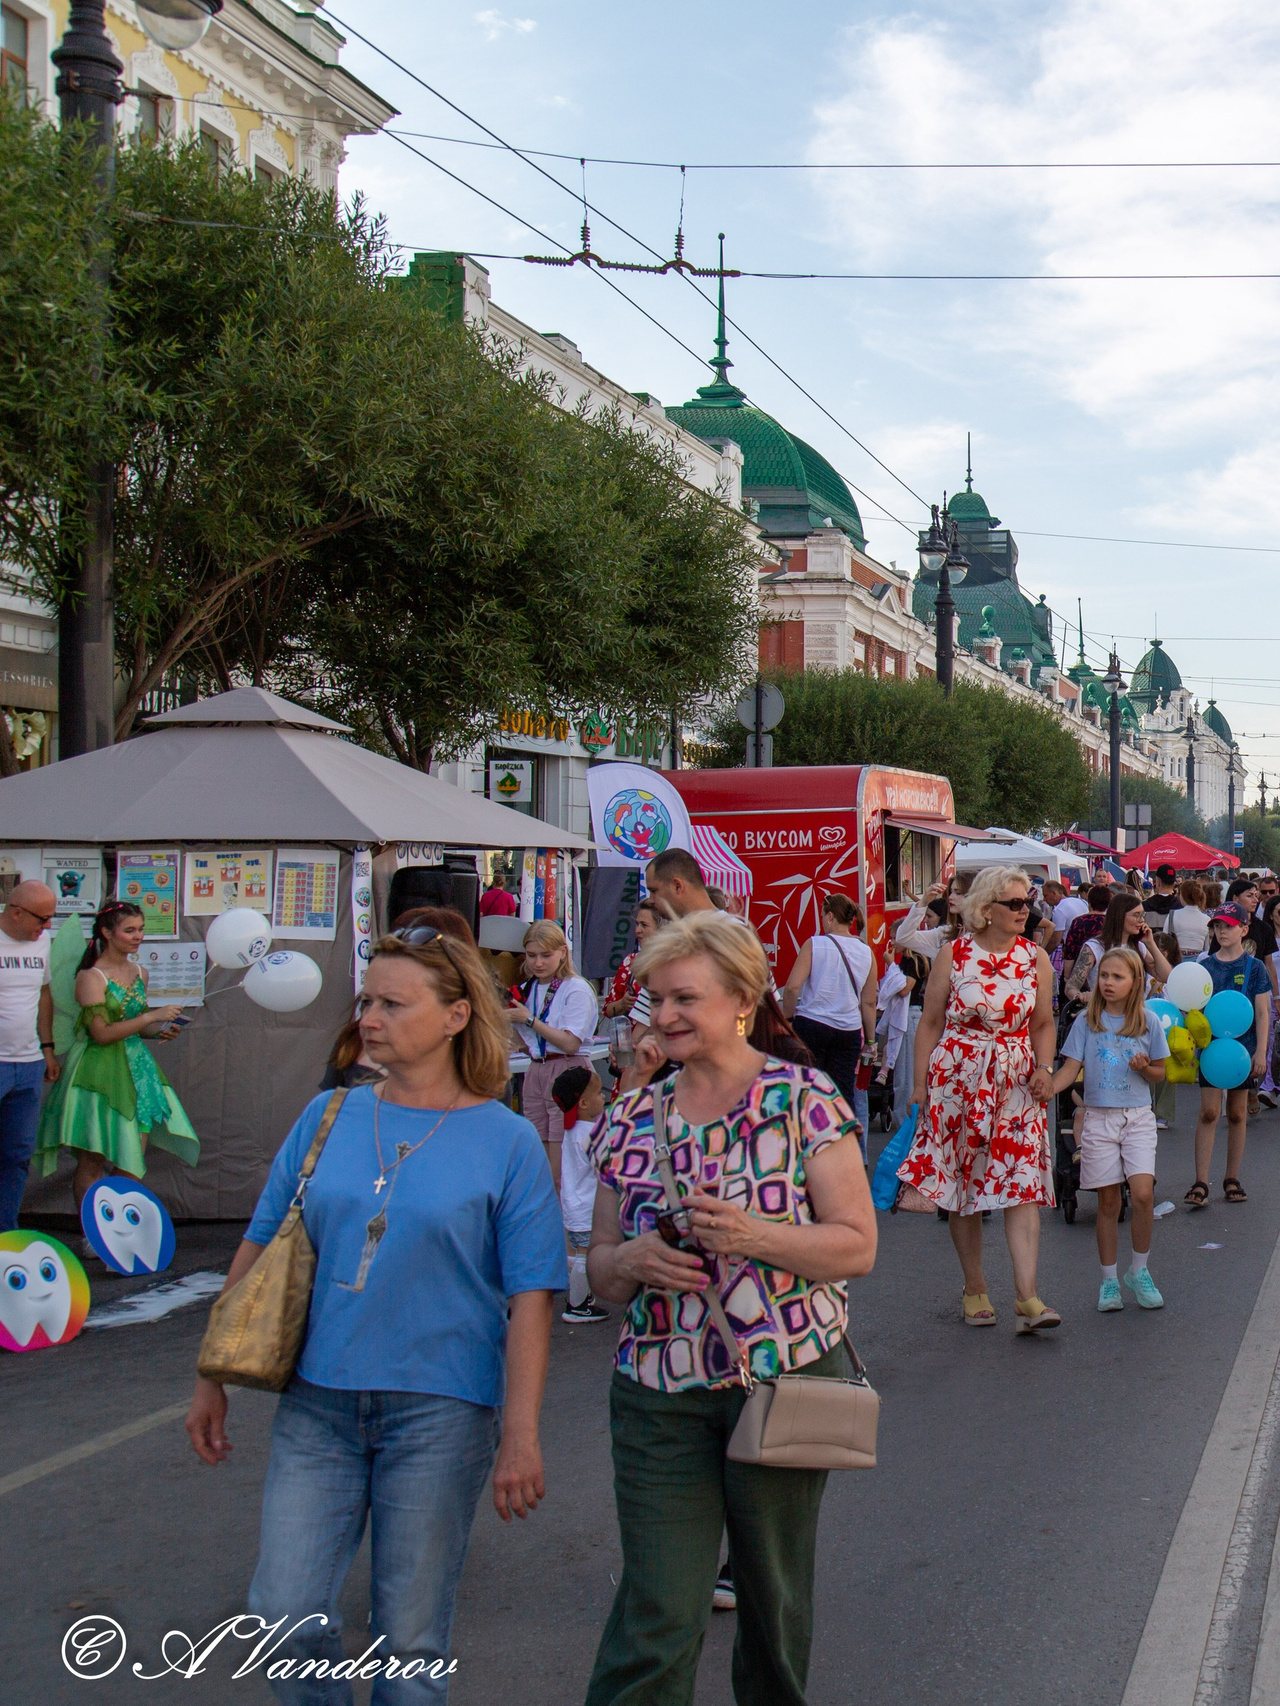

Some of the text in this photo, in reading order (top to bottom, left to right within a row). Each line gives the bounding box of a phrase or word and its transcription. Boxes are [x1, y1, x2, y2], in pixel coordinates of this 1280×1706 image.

[0, 670, 54, 689] ESSORIES
[745, 830, 813, 849] ВКУСОМ
[23, 957, 45, 969] KLEIN
